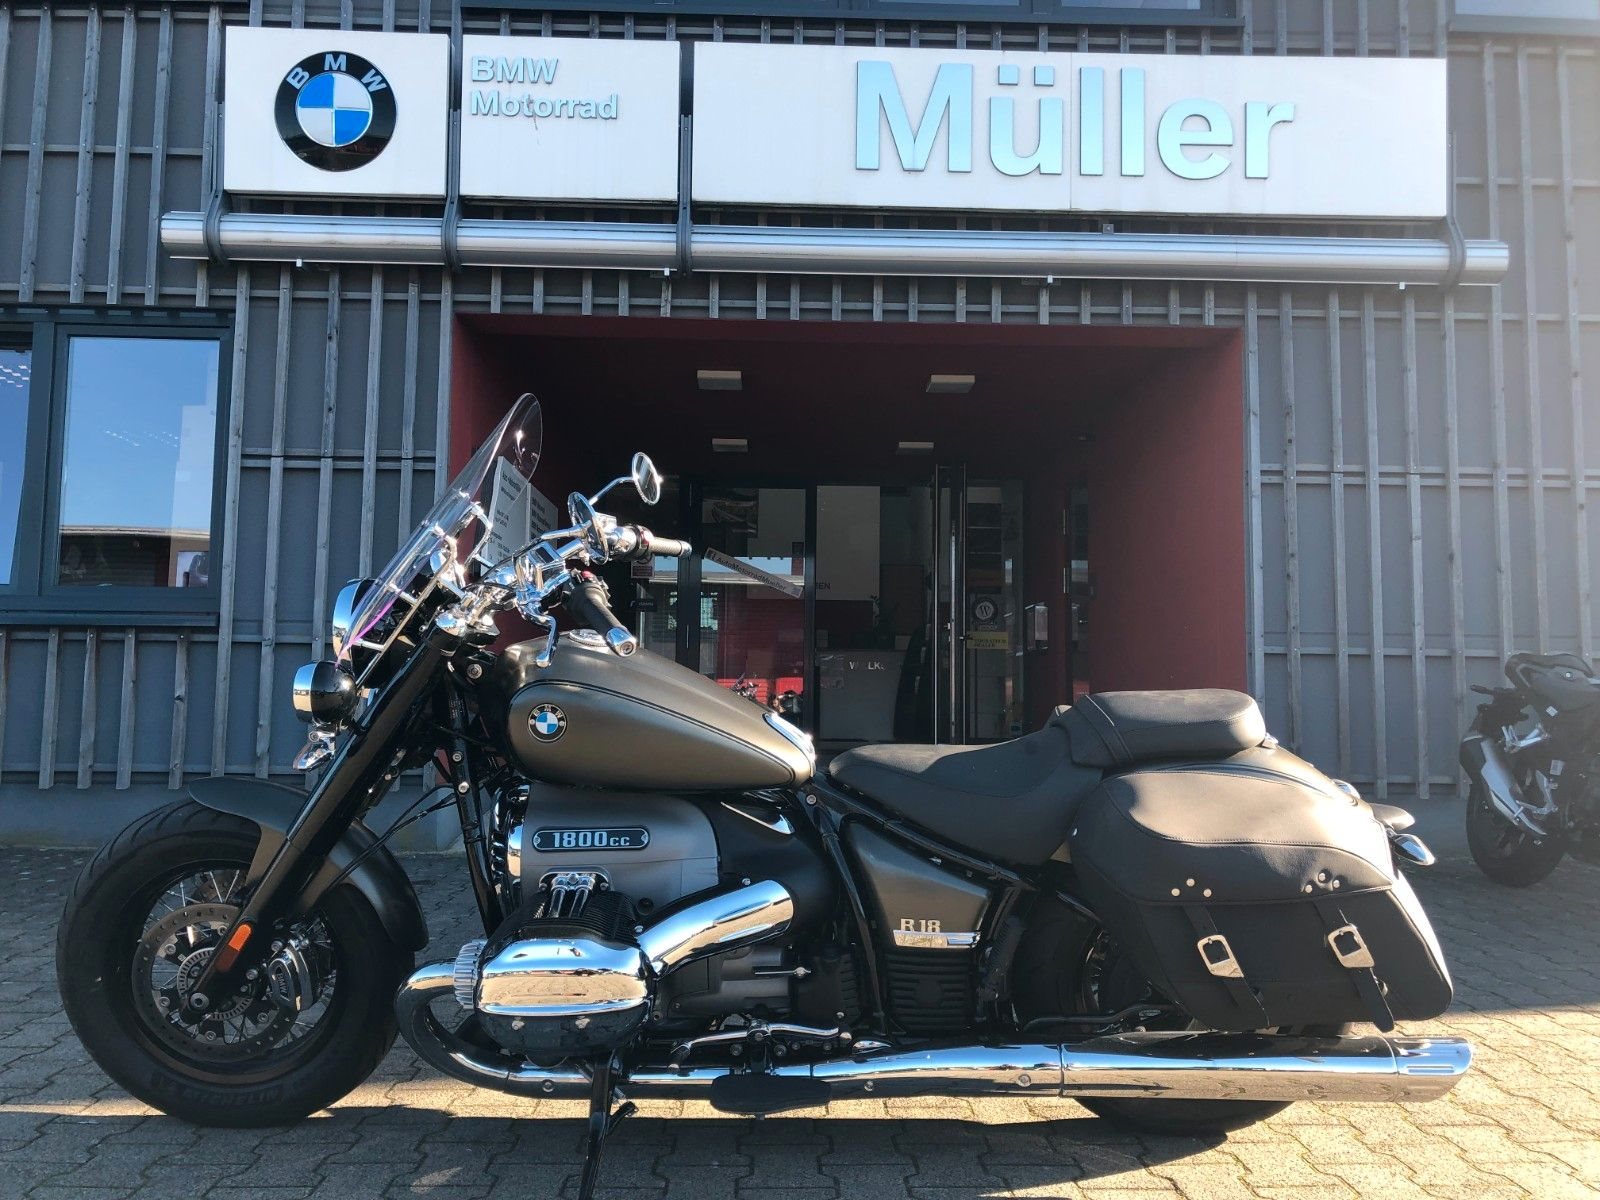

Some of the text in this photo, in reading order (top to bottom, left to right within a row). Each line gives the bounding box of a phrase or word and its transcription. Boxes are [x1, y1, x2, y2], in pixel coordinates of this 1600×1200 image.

[286, 54, 387, 92] BMW
[471, 56, 559, 84] BMW
[471, 89, 619, 120] Motorrad
[855, 60, 1296, 180] Müller
[552, 831, 630, 848] 1800cc
